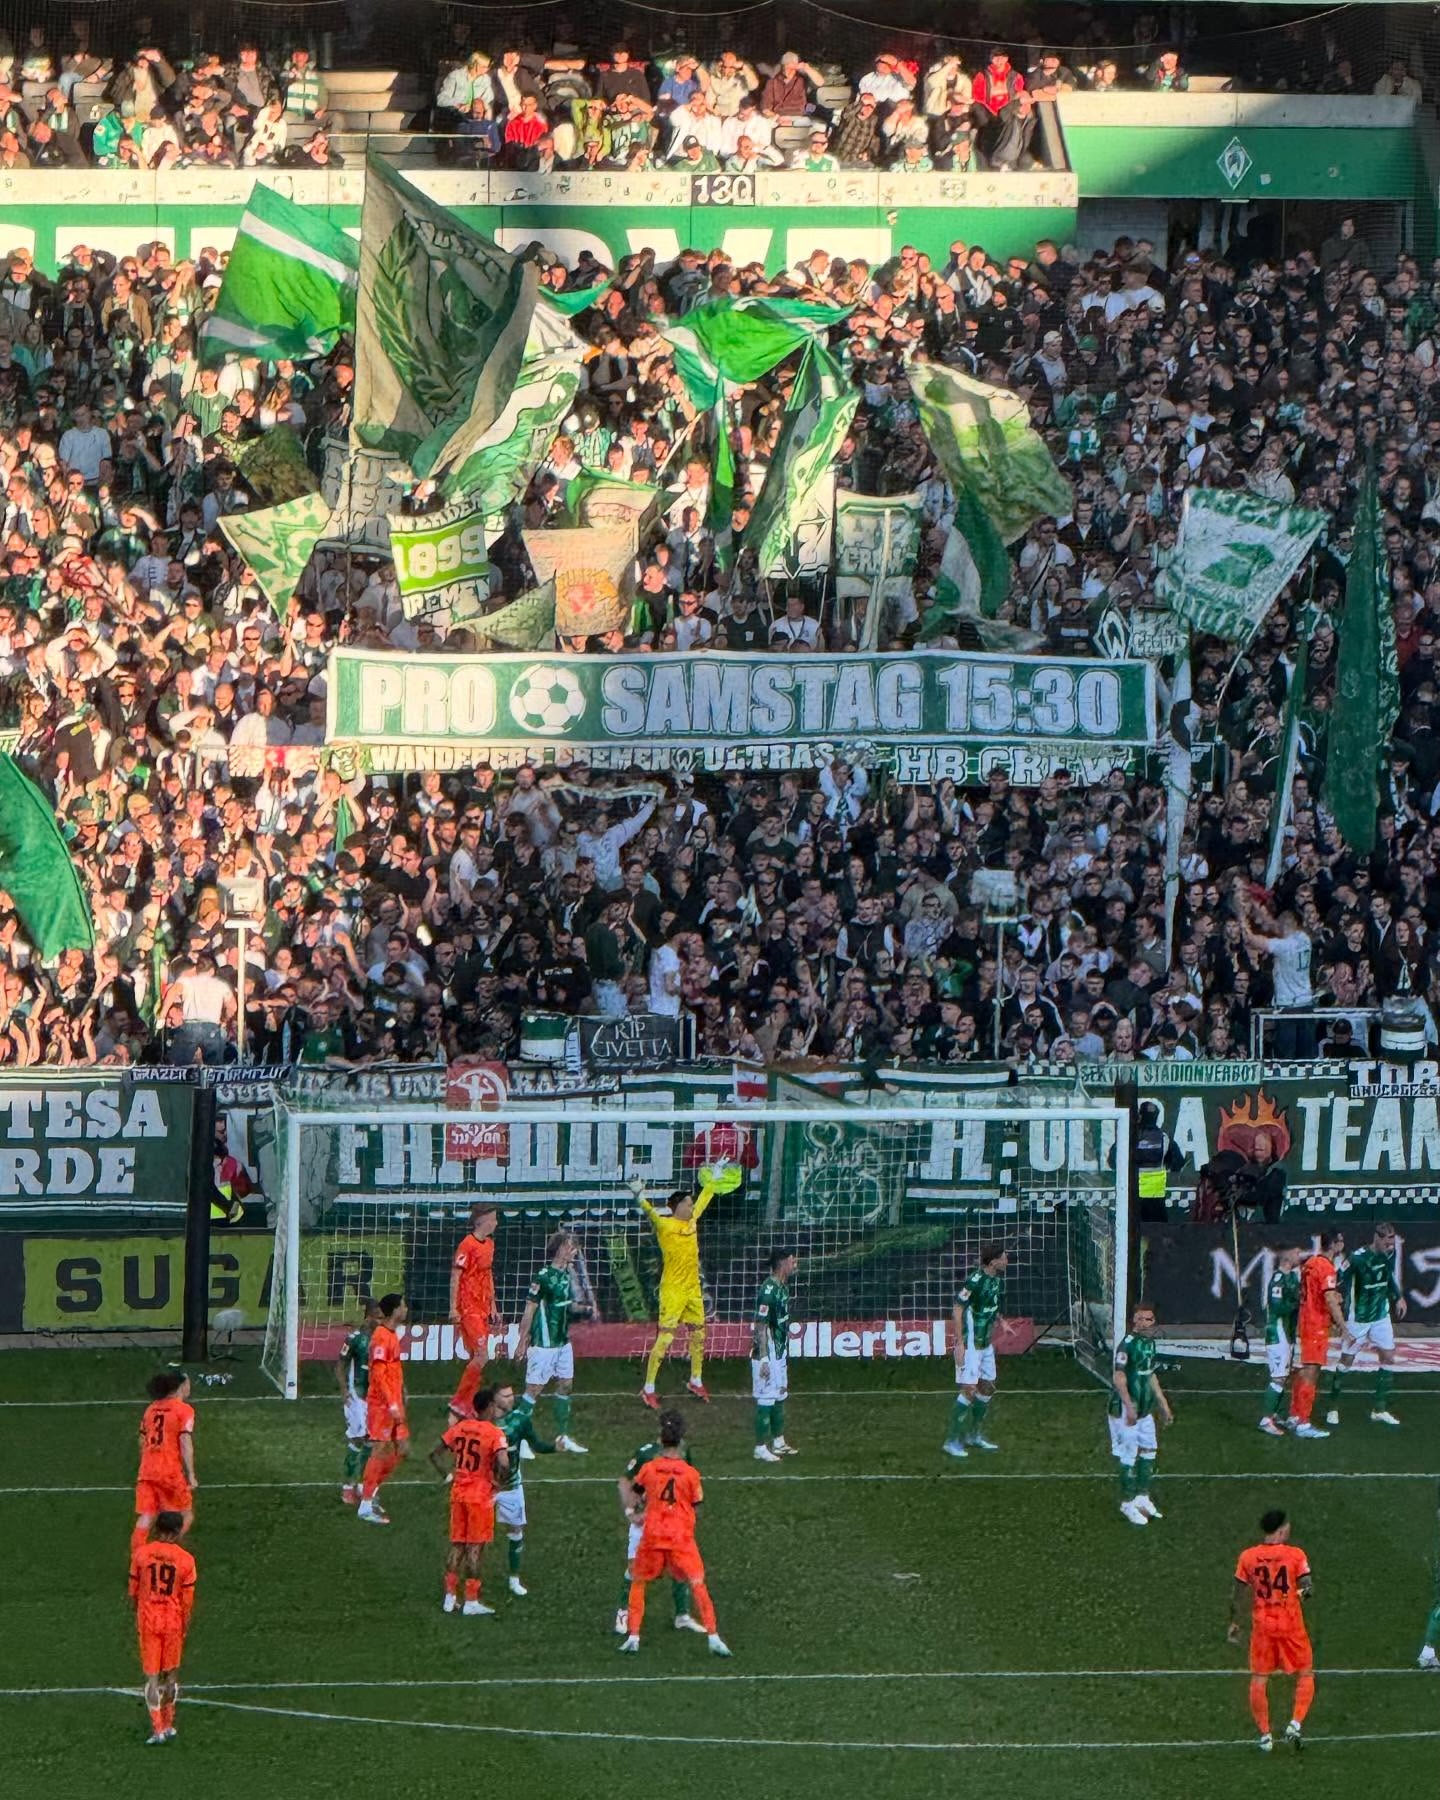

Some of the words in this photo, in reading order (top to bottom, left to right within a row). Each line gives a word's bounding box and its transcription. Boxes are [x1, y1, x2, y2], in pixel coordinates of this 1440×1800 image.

[694, 175, 753, 204] 130
[391, 525, 489, 582] 1899
[359, 662, 497, 736] PRO
[601, 660, 923, 738] SAMSTAG
[935, 660, 1122, 738] 15:30
[371, 745, 545, 772] WANDERERS
[703, 743, 835, 771] ULTRAS
[896, 745, 968, 785] HB
[614, 1019, 646, 1040] RIP
[132, 1067, 188, 1082] GRAZER
[207, 1066, 288, 1083] STURMFLUT
[1143, 1063, 1259, 1084] STADIONVERBOT
[1349, 1084, 1440, 1098] UNVERGESS
[0, 1089, 168, 1139] TESA
[0, 1147, 137, 1195] RDE
[55, 1251, 374, 1313] SUGR
[787, 1320, 947, 1358] illertal
[151, 1413, 166, 1446] 3
[660, 1477, 676, 1505] 4
[148, 1561, 177, 1597] 19
[1254, 1565, 1290, 1600] 34
